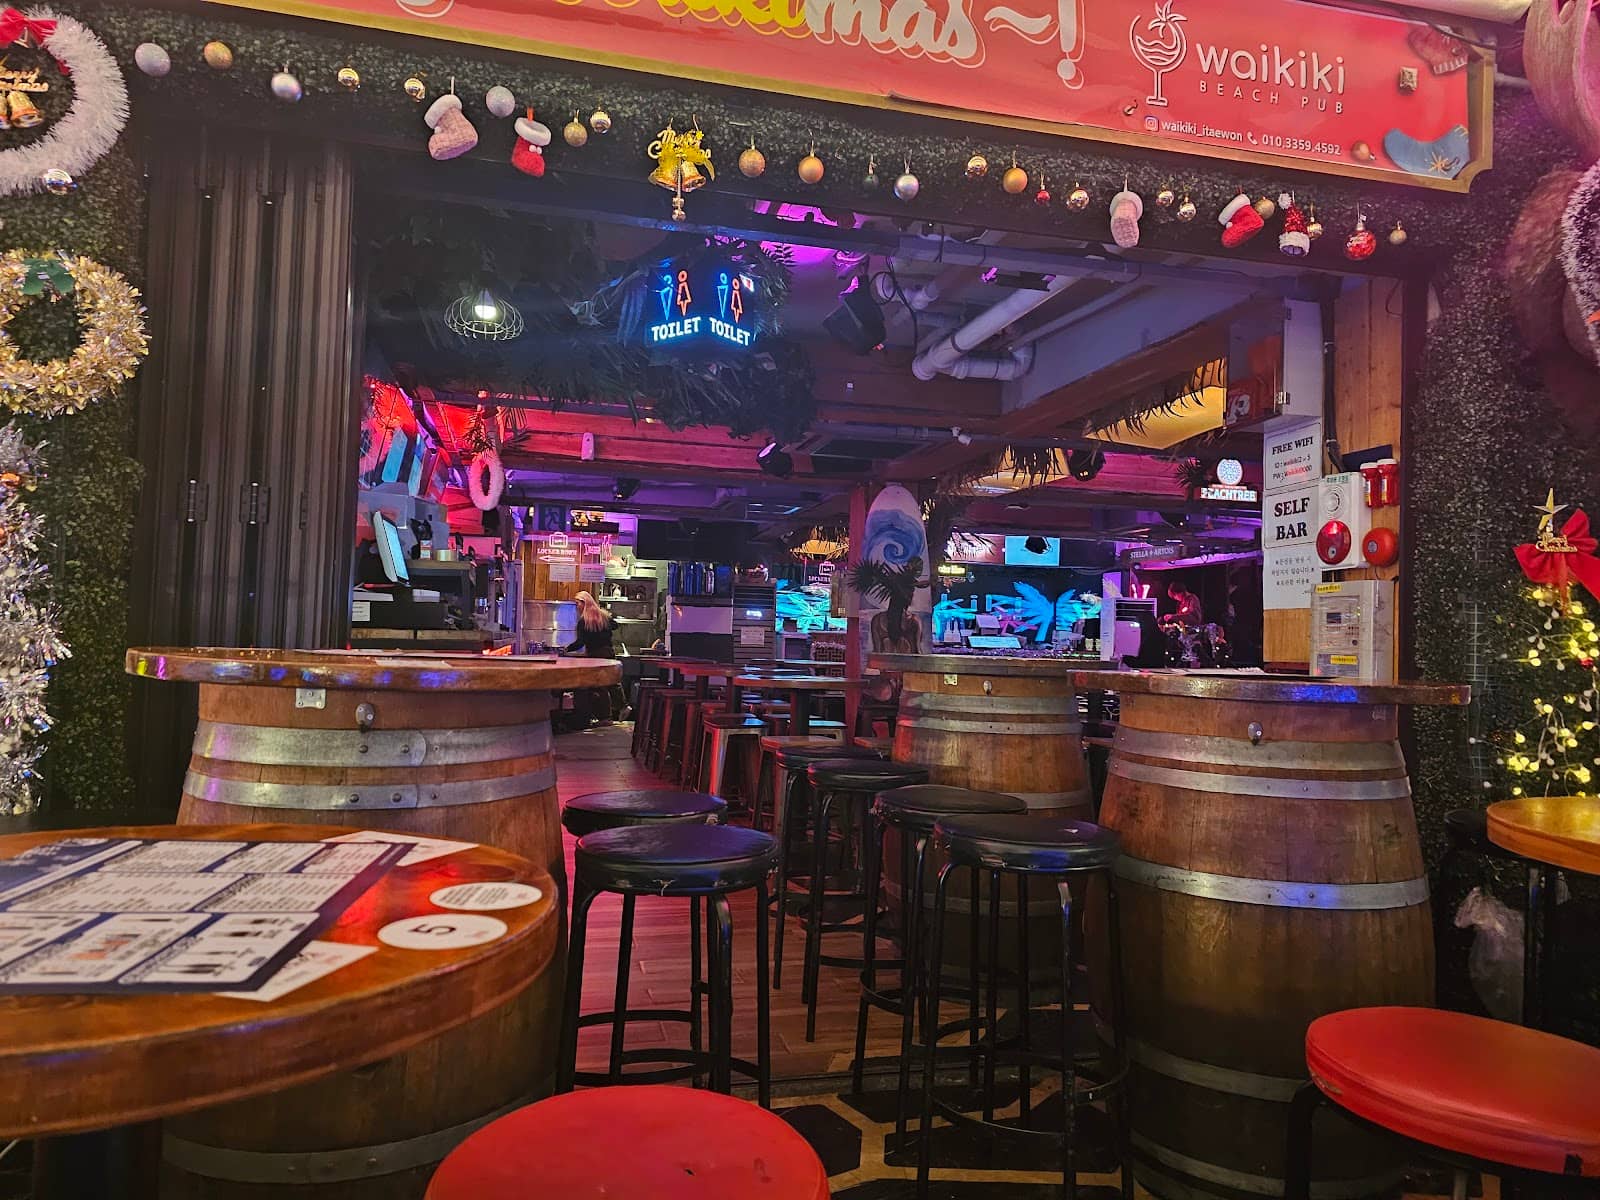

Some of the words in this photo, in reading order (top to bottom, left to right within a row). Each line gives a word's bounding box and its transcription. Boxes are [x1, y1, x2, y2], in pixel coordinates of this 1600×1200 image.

[1196, 43, 1345, 94] waikiki
[1199, 80, 1280, 104] BEACH
[1301, 96, 1343, 114] PUB
[1162, 120, 1243, 142] waikiki_itaewon
[1262, 134, 1341, 155] 010.3359.4592
[651, 316, 701, 342] TOILET
[709, 317, 751, 346] TOILET
[1272, 442, 1293, 455] FREE
[1295, 436, 1313, 449] WIFI
[1274, 497, 1310, 517] SELF
[1276, 522, 1308, 540] BAR
[408, 923, 457, 937] 5
